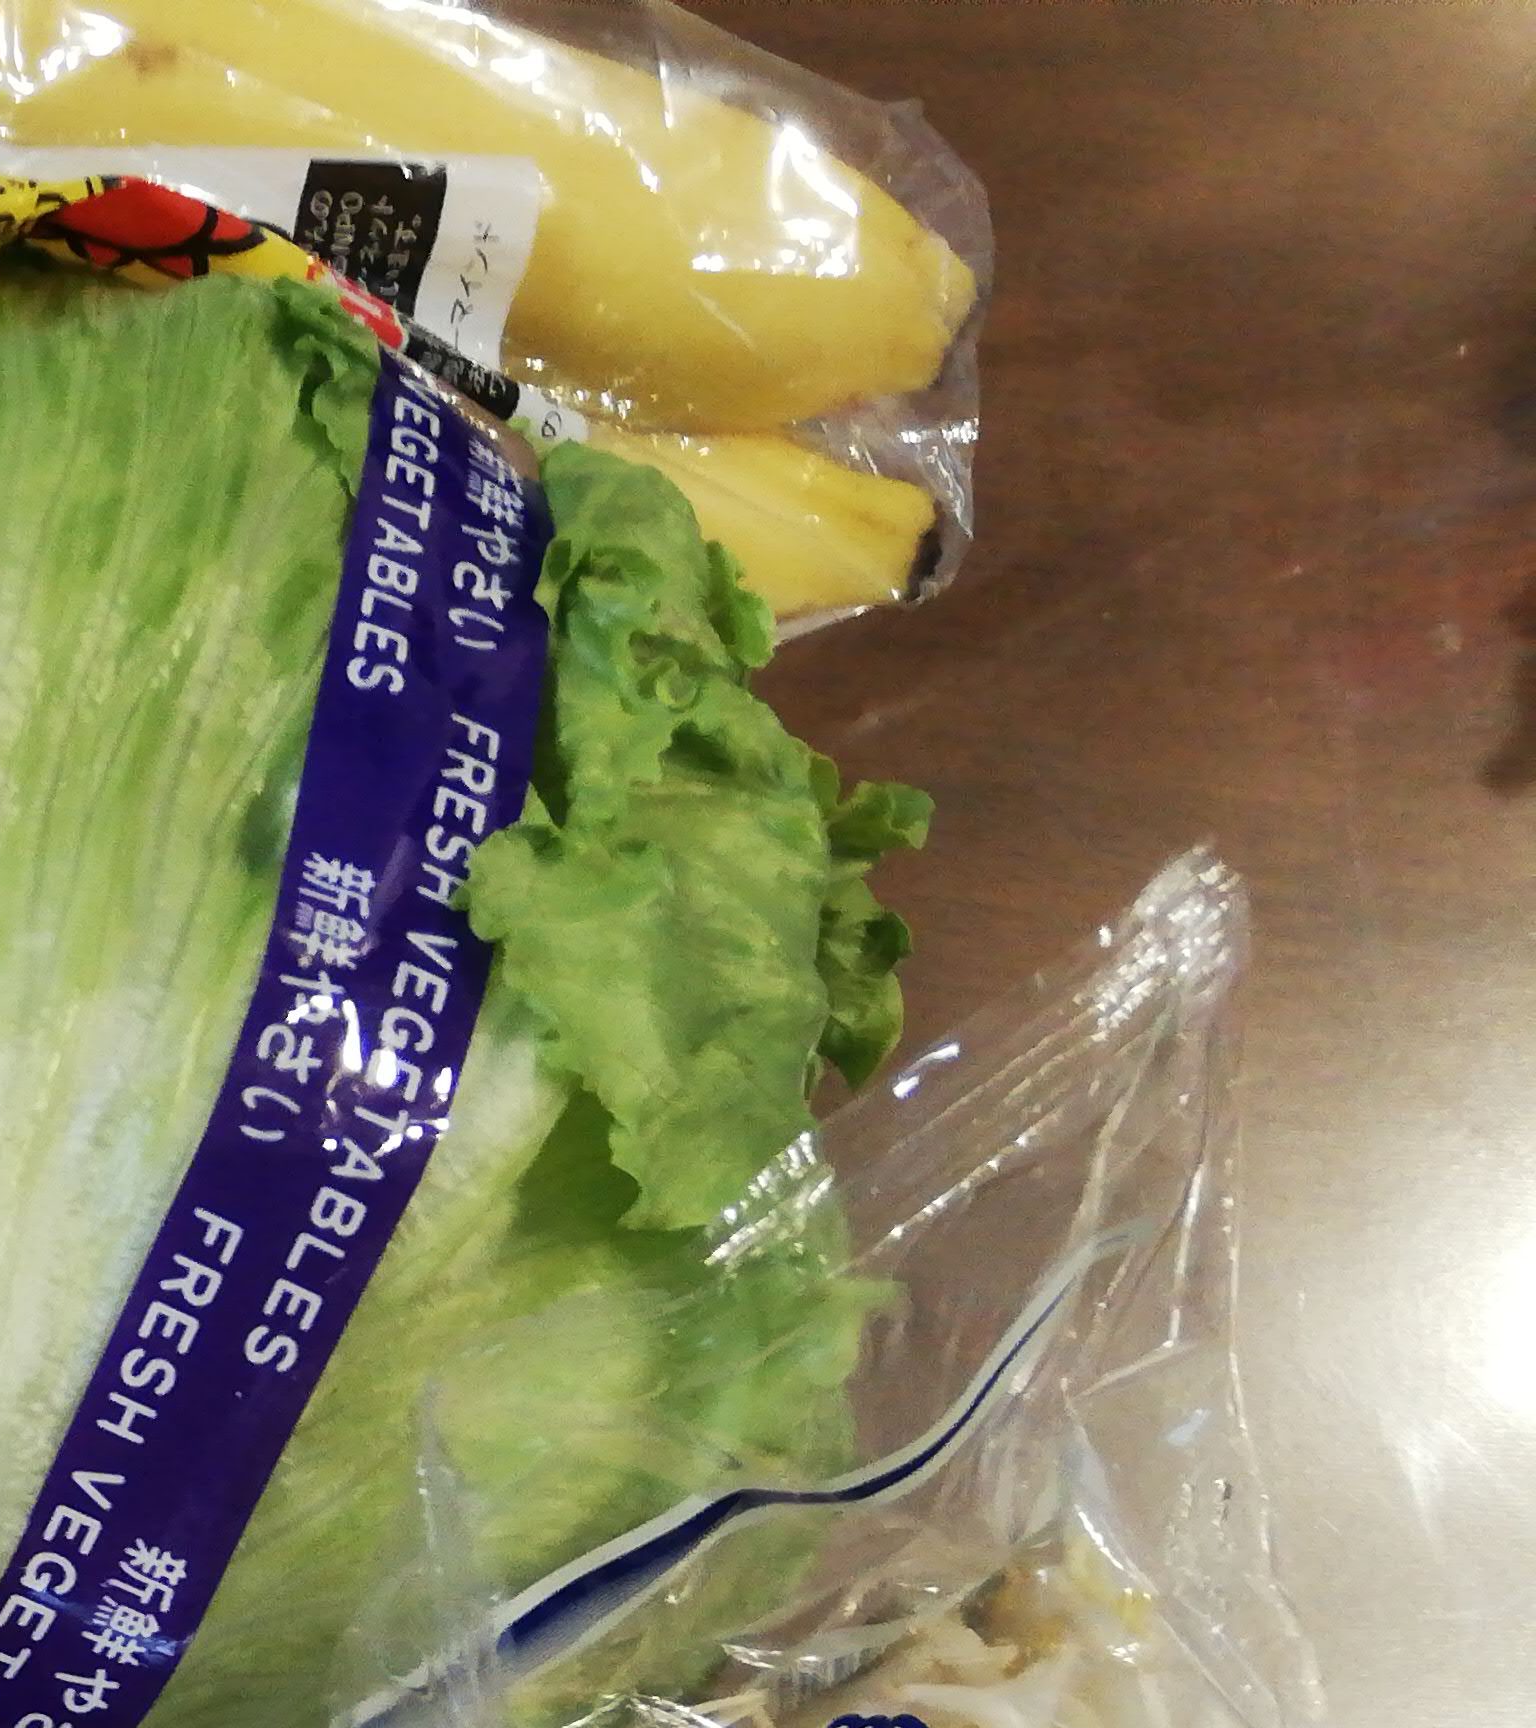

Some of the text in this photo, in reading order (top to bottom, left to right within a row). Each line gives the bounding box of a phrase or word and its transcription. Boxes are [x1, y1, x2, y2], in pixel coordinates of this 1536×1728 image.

[345, 371, 442, 698] VEGETABLES
[453, 437, 528, 653] 新鮮やさい
[422, 712, 501, 906] FRESH
[239, 849, 375, 1146] 新鮮やさい
[244, 929, 459, 1376] VEGETABLES
[96, 1204, 245, 1446] FRESH
